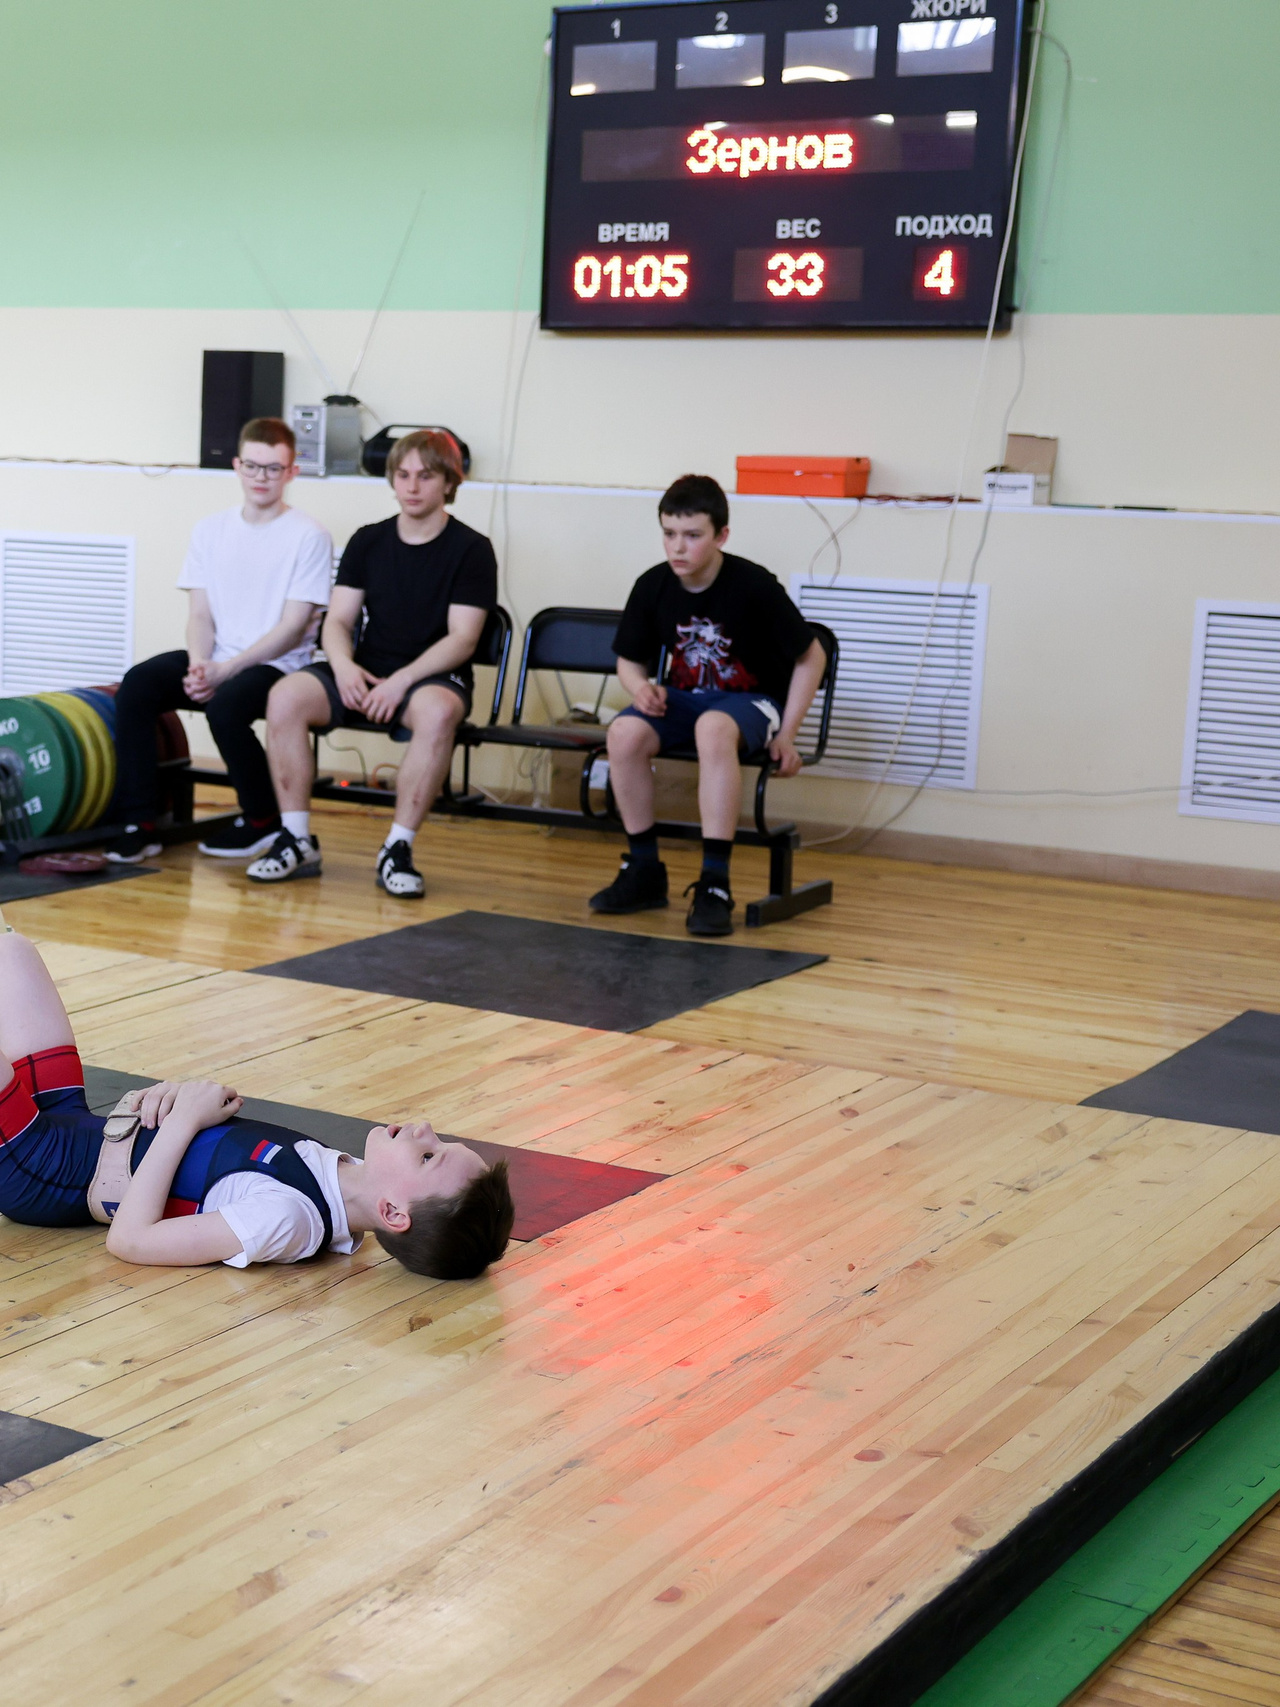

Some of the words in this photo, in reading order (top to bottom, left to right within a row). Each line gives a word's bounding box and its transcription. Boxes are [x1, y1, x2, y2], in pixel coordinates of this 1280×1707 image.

[610, 18, 622, 39] 1
[714, 11, 730, 32] 2
[824, 3, 839, 24] 3
[910, 0, 986, 19] ЖЮРИ
[685, 129, 854, 179] Зернов
[598, 221, 670, 243] ВРЕМЯ
[775, 218, 822, 239] ВЕС
[895, 213, 993, 239] ПОДХОД
[574, 254, 689, 298] 01:05
[766, 252, 825, 296] 33
[923, 249, 955, 295] 4
[27, 749, 51, 770] 10
